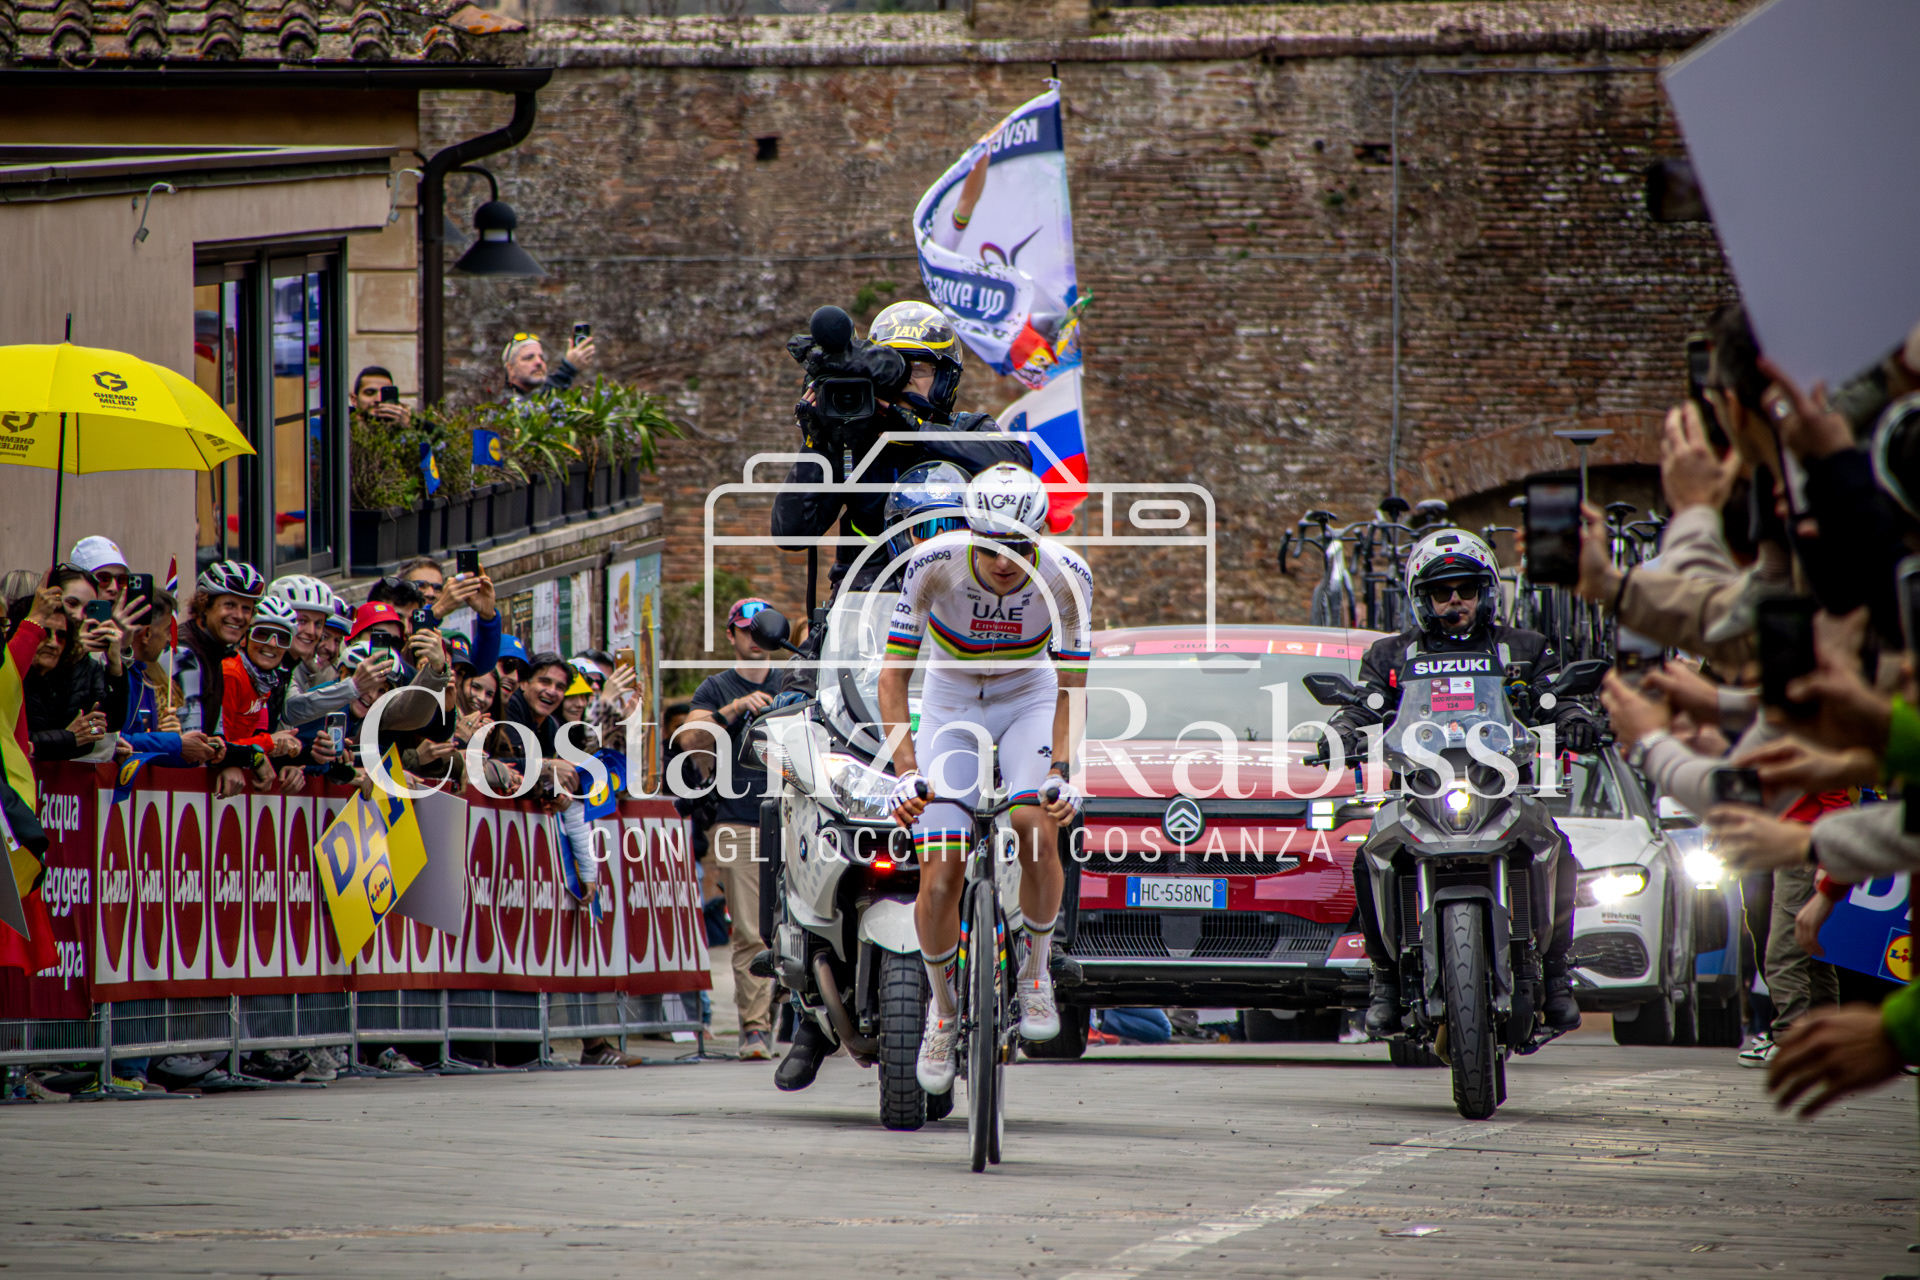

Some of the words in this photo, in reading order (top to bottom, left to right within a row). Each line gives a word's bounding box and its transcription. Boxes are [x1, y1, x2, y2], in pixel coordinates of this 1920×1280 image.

[93, 392, 138, 402] GHEMKO
[99, 398, 136, 407] MILIEU
[914, 550, 952, 571] Analog
[972, 602, 1024, 622] UAE
[891, 620, 919, 632] mirates
[975, 622, 1018, 632] Emirates
[1414, 658, 1491, 675] SUZUKI
